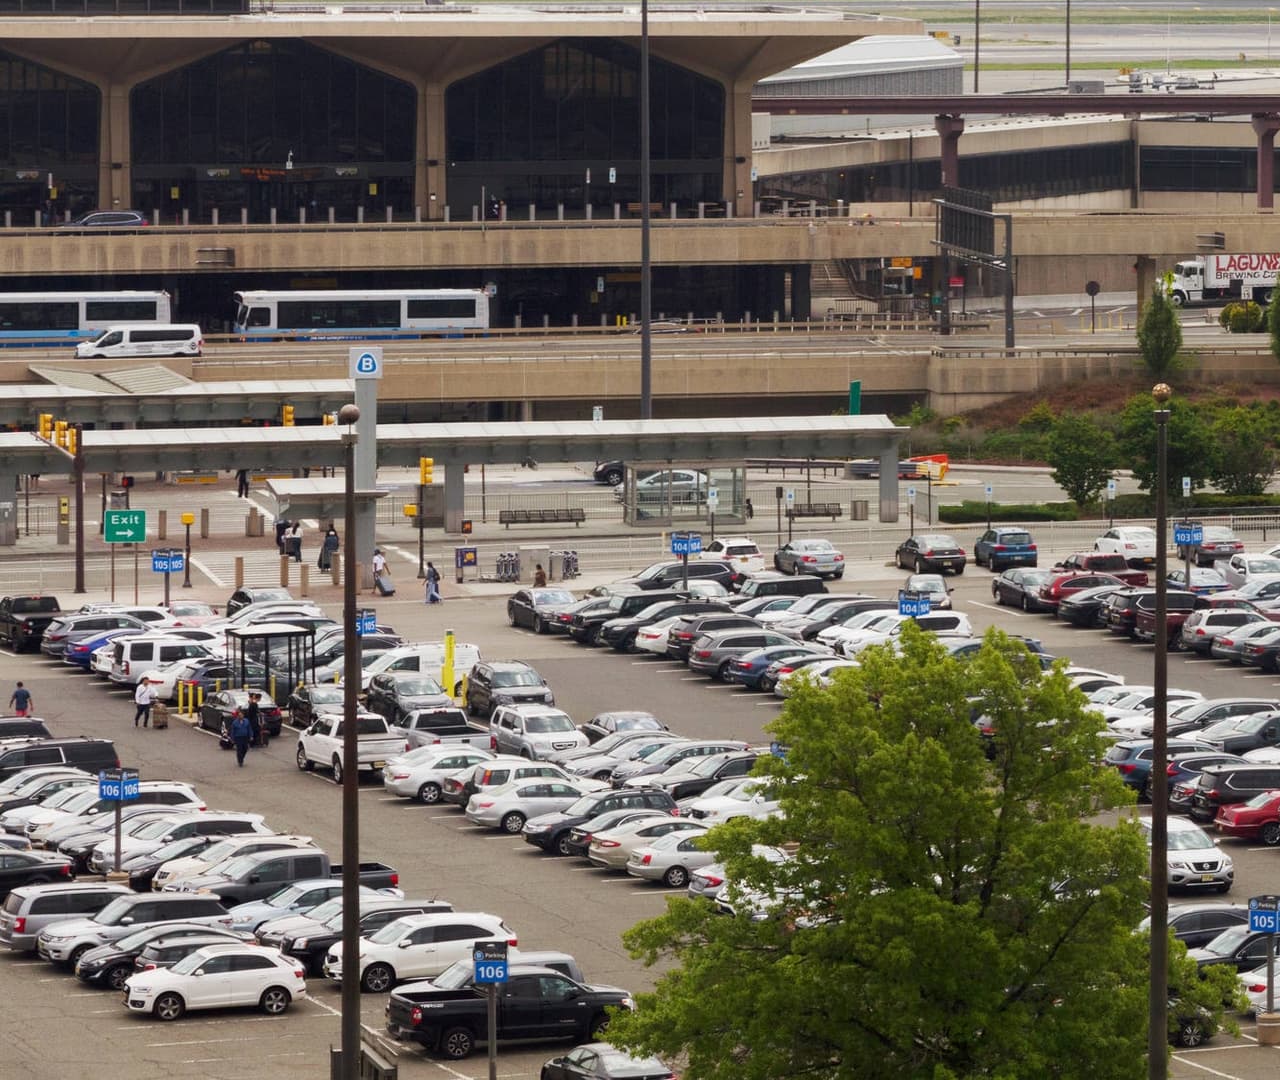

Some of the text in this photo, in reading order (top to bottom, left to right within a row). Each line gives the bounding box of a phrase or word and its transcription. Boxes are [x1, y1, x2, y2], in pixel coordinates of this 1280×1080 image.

[362, 358, 373, 370] B
[111, 515, 139, 525] Exit
[1176, 533, 1190, 541] 103
[673, 542, 687, 551] 104
[154, 560, 169, 569] 105
[171, 560, 183, 569] 105
[901, 604, 917, 613] 104
[364, 621, 375, 630] 105
[102, 785, 119, 796] 106
[124, 784, 137, 795] 106
[1253, 916, 1274, 928] 105
[485, 953, 505, 961] Parking
[479, 966, 504, 979] 106
